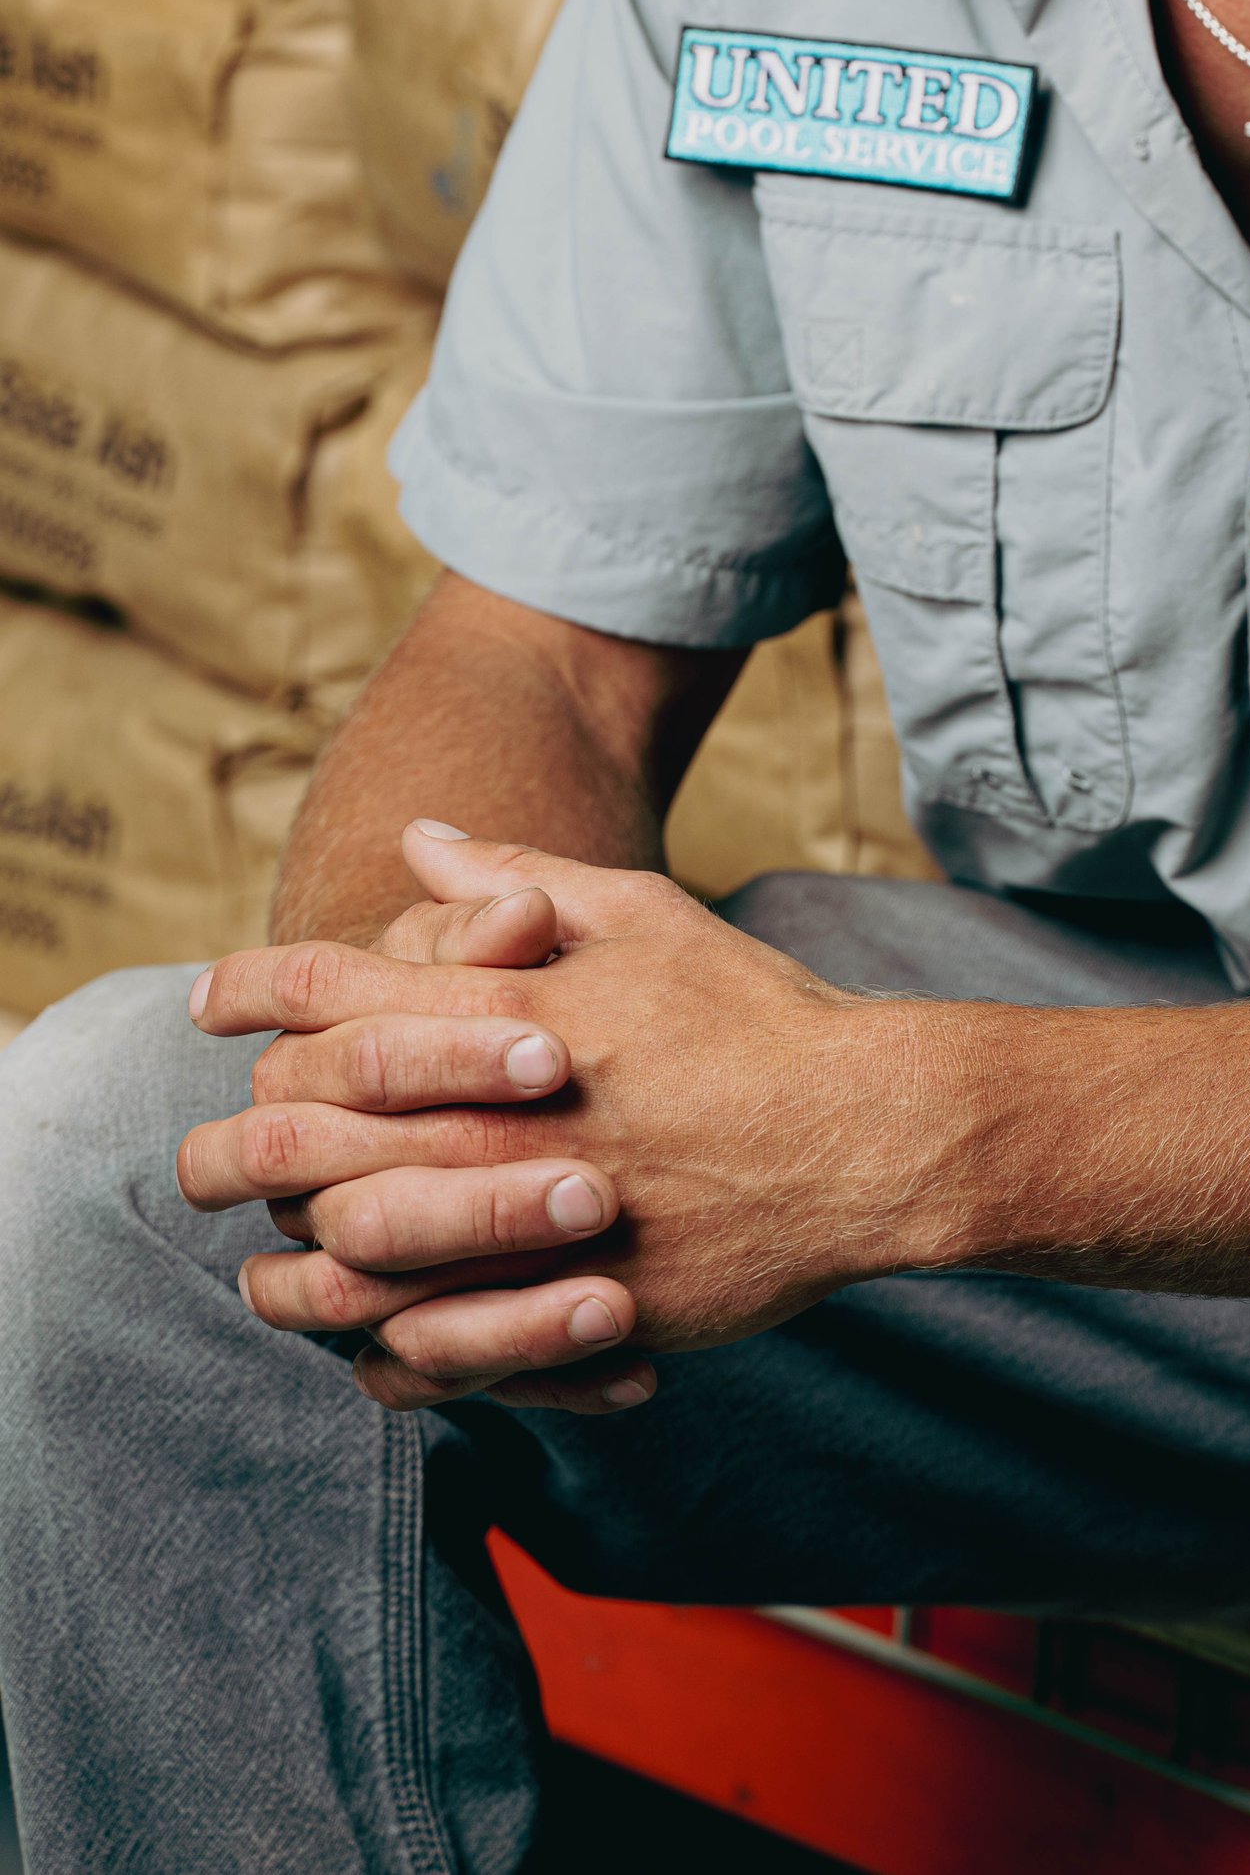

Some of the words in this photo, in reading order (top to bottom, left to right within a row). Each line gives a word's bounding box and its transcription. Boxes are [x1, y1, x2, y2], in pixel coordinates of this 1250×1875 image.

[690, 44, 1020, 139] UNITED
[683, 110, 812, 161] POOL
[821, 128, 1010, 184] SERVICE
